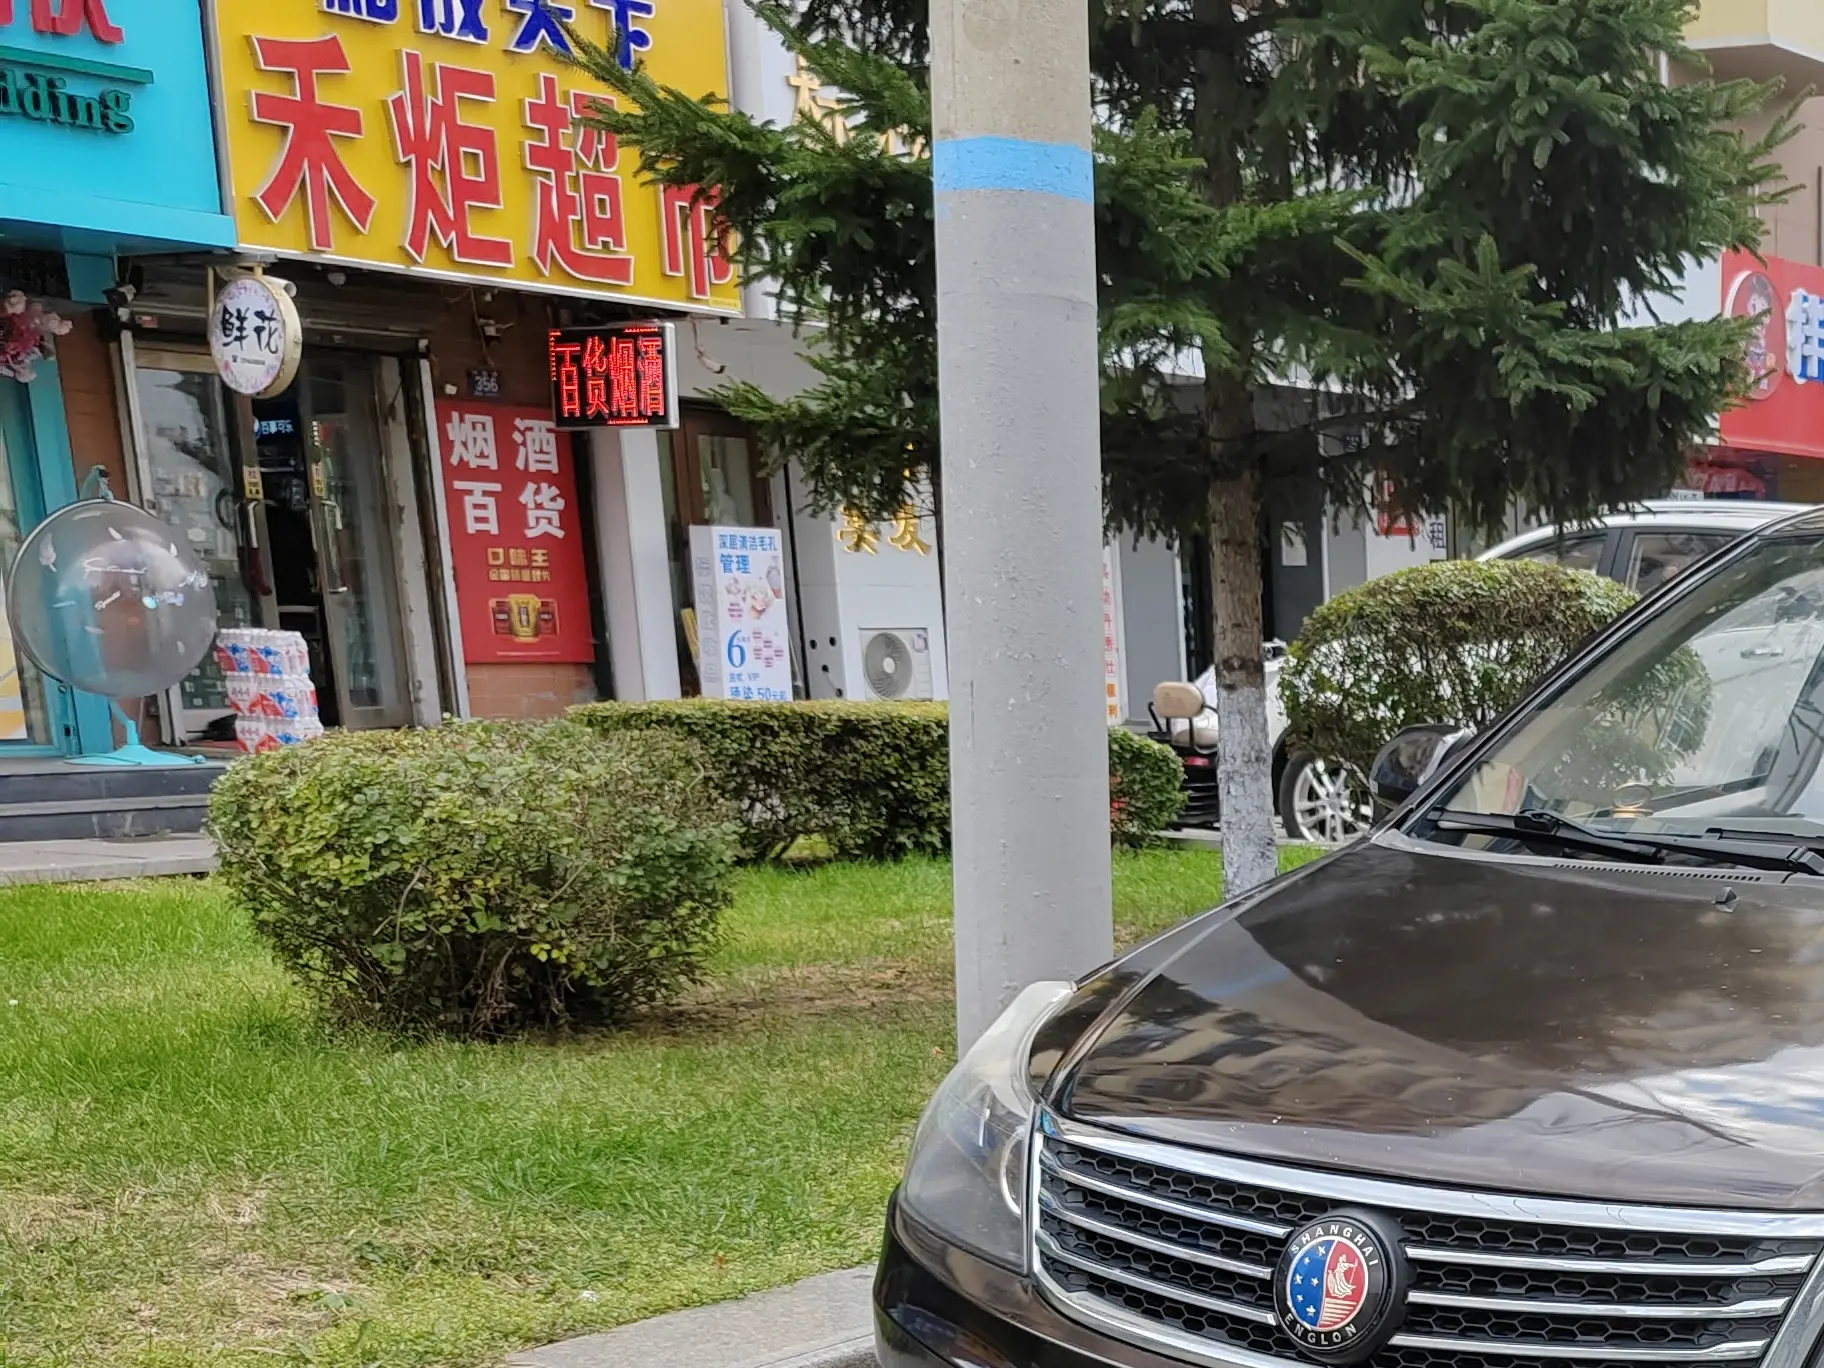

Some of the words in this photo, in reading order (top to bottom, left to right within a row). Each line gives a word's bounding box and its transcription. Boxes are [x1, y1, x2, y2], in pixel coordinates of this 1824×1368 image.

[246, 33, 736, 300] 禾炬超市
[222, 304, 280, 355] 鲜花
[555, 335, 665, 418] 百货烟酒
[447, 411, 559, 474] 烟酒
[453, 480, 566, 539] 百货
[487, 547, 550, 567] 口味王
[720, 553, 751, 574] 管理
[727, 629, 746, 668] 6
[1291, 1224, 1379, 1266] SHANGHAI
[1284, 1313, 1357, 1345] ENGLON
